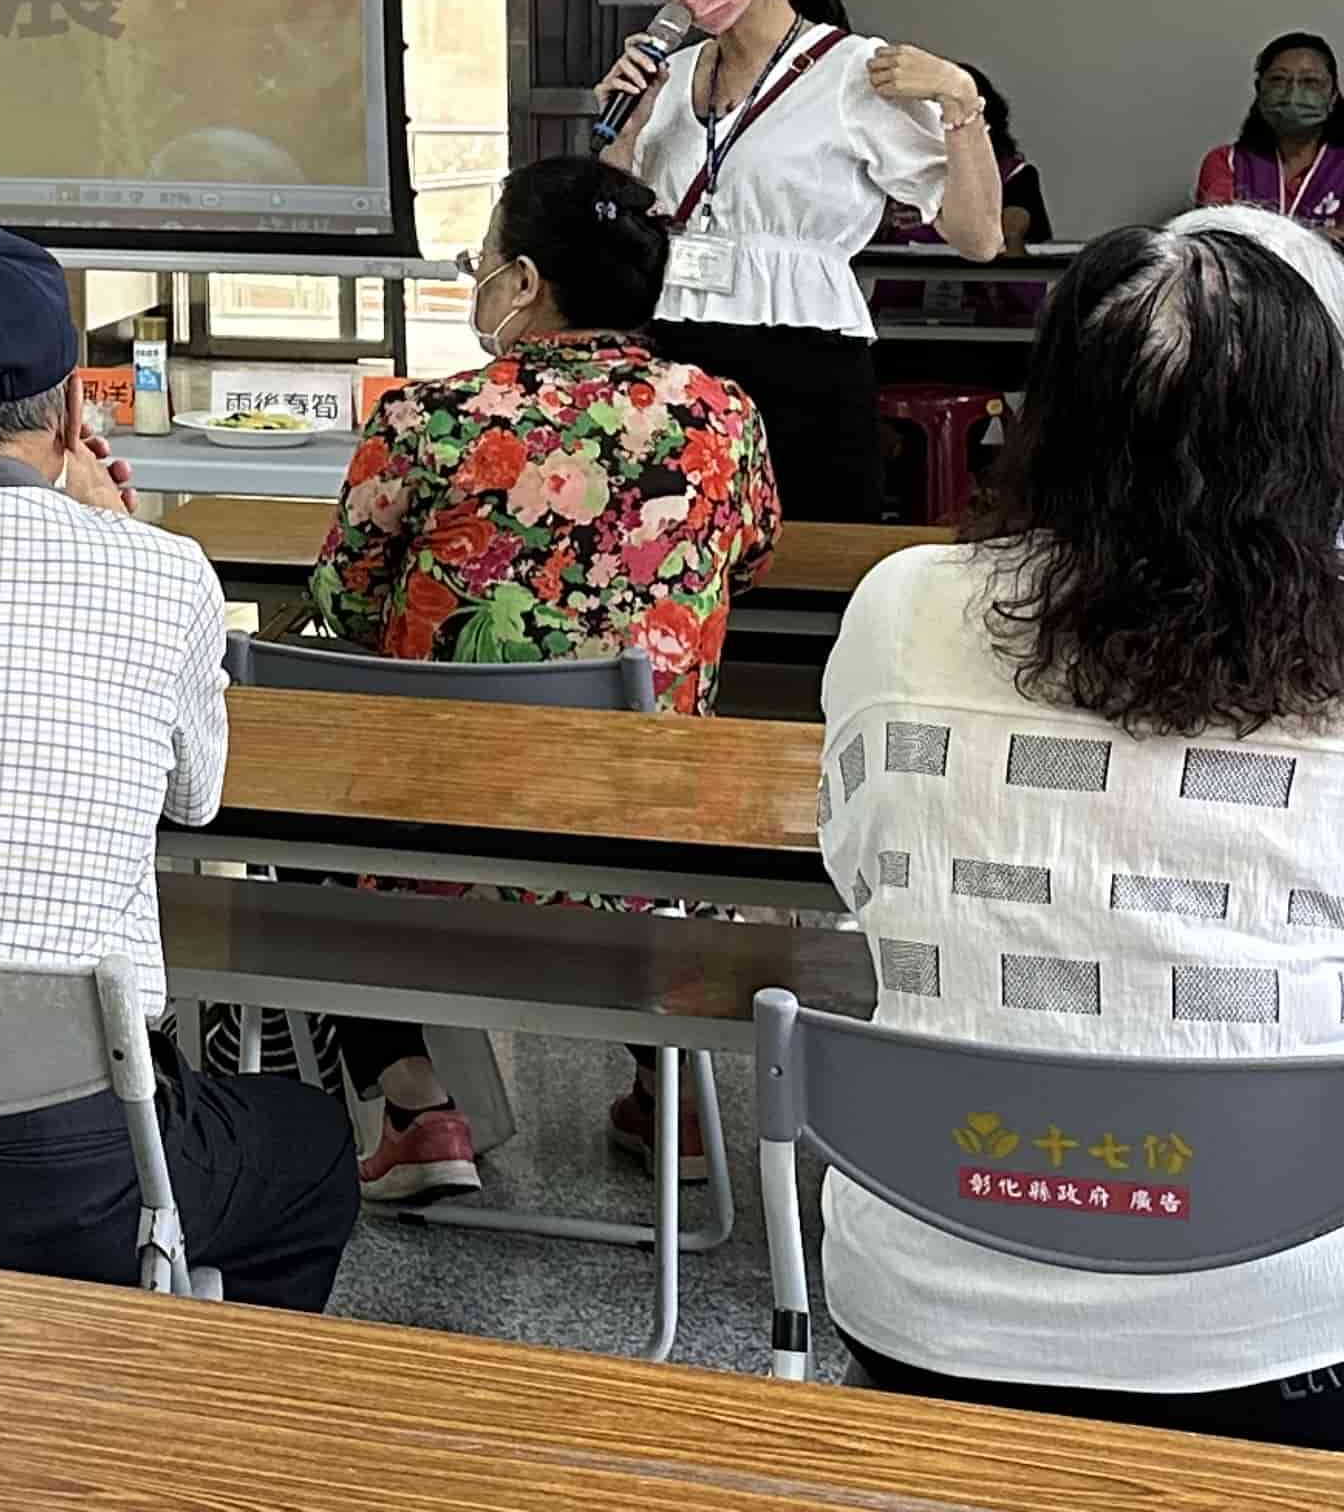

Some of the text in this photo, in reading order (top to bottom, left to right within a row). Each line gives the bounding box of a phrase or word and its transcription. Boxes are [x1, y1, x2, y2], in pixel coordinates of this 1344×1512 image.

[1032, 1122, 1193, 1176] 十七份
[967, 1173, 1182, 1214] 彰化縣政府 廣告
